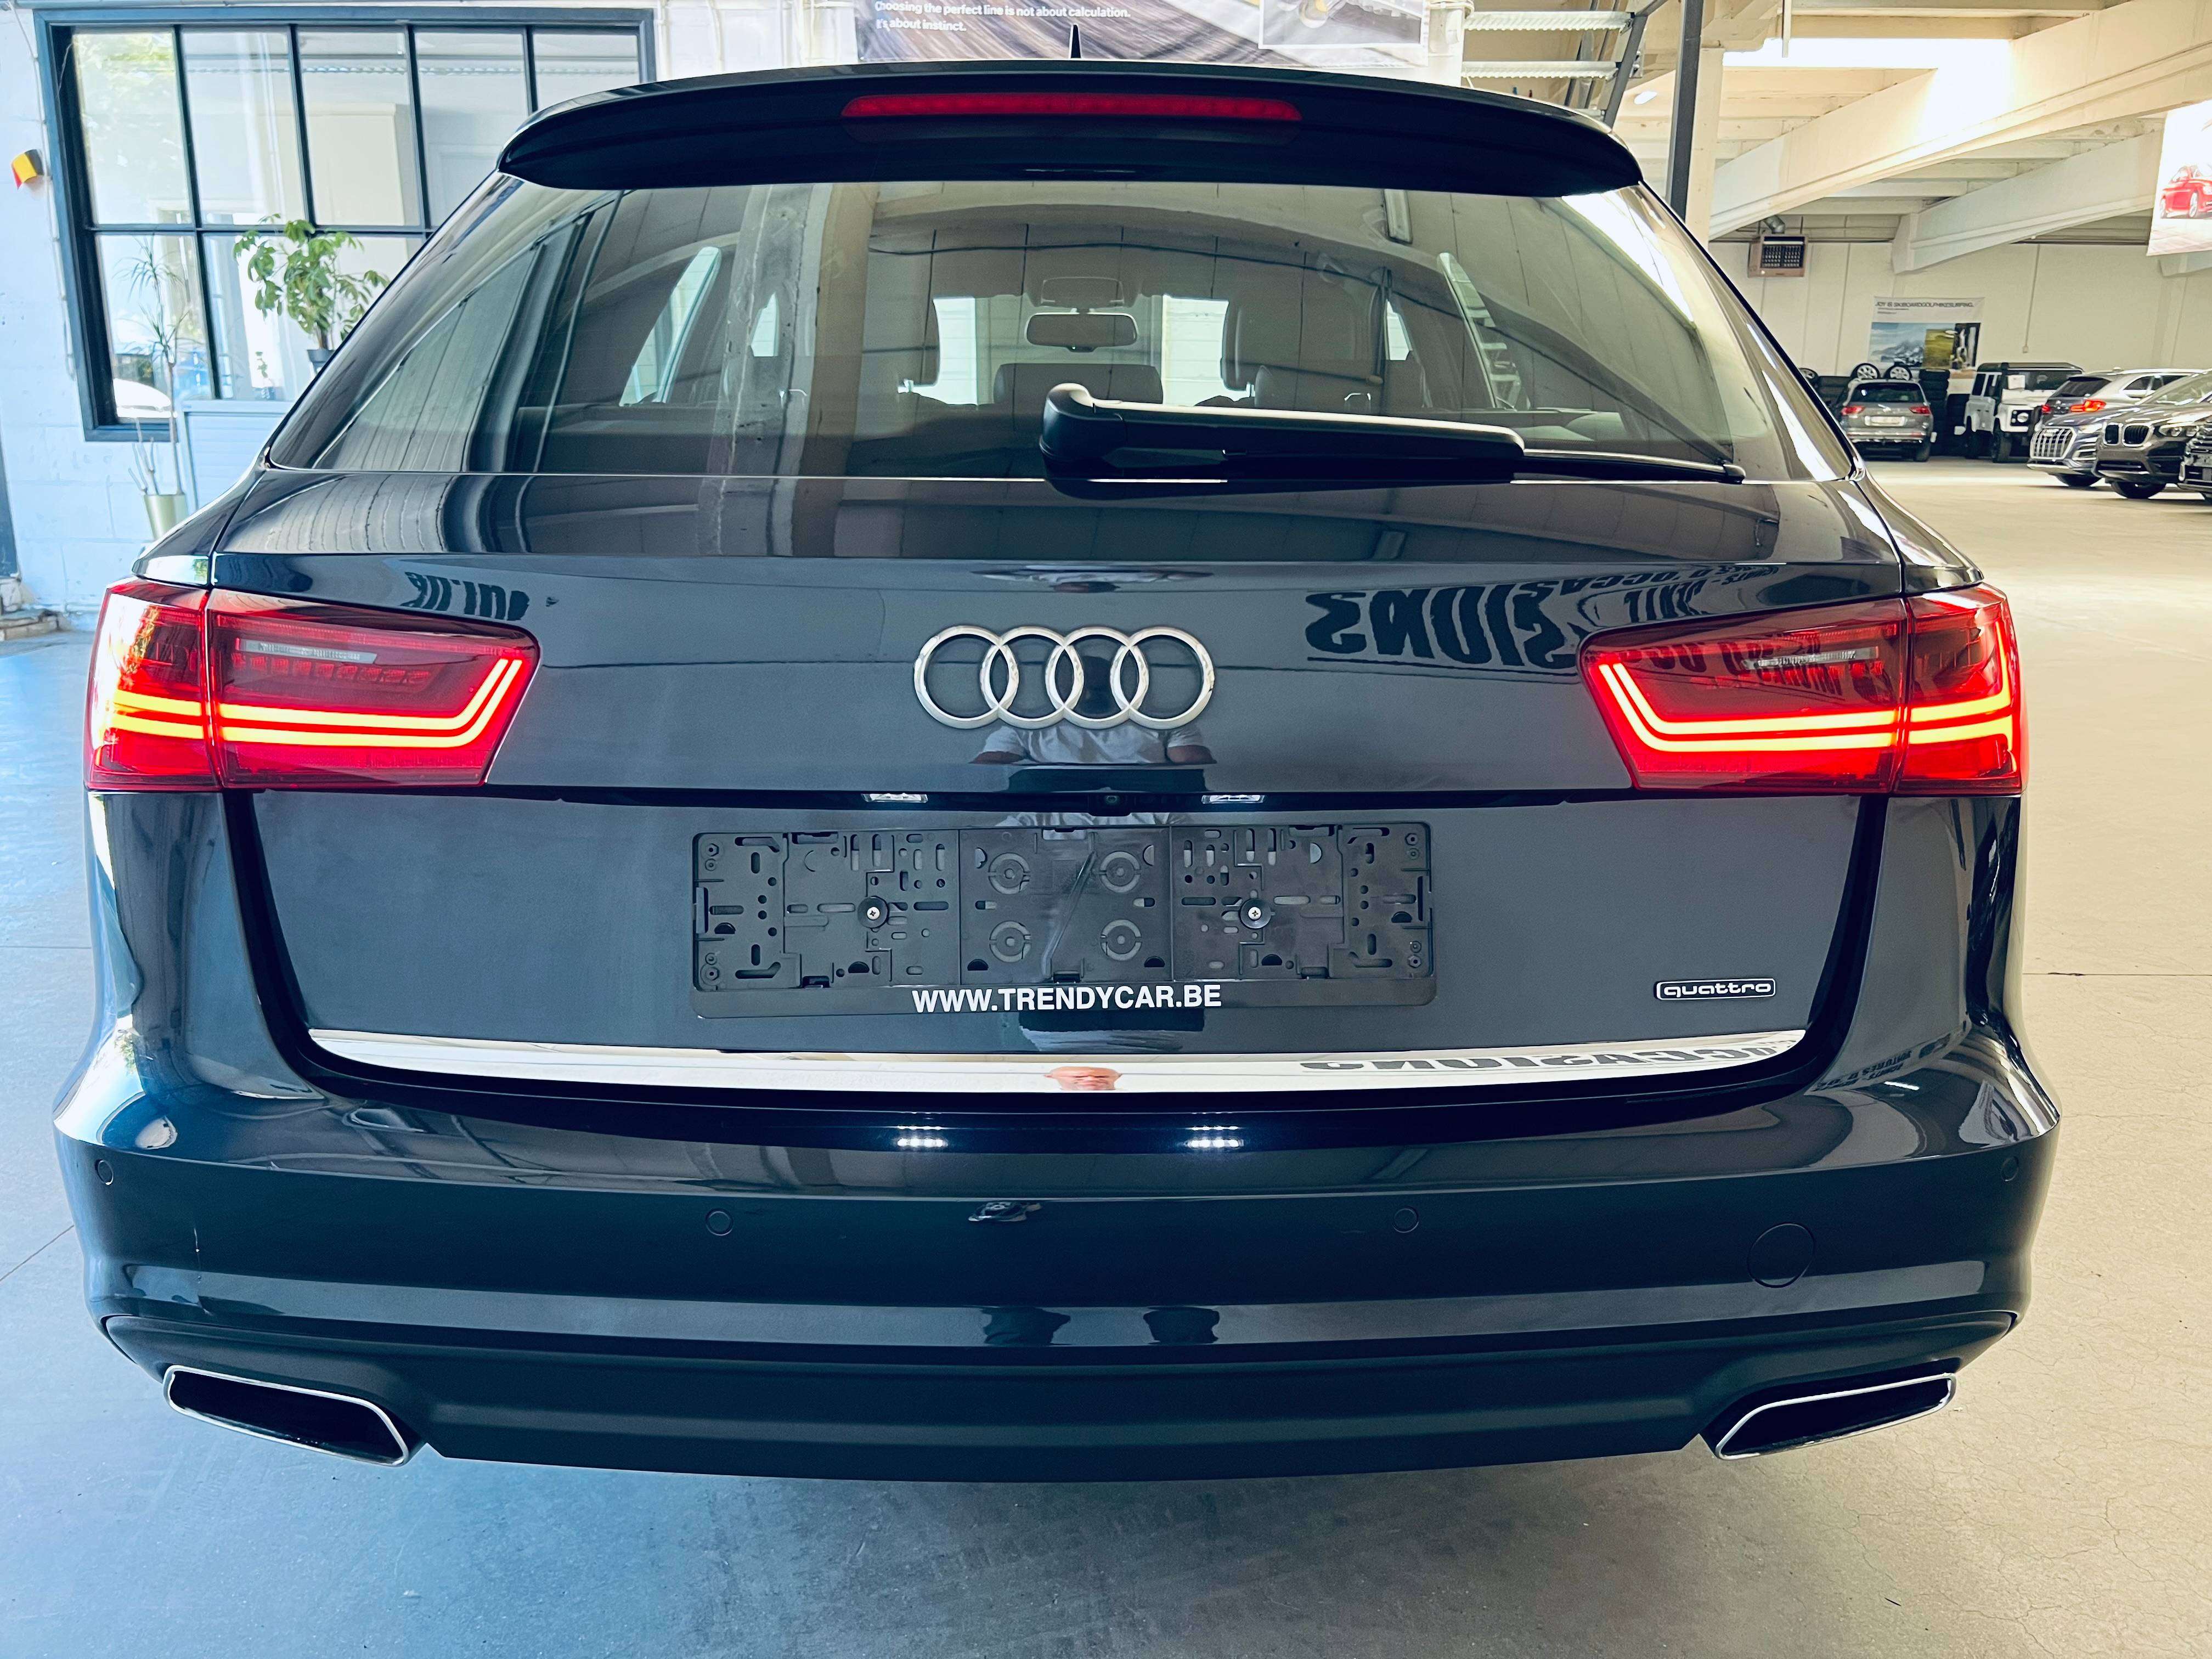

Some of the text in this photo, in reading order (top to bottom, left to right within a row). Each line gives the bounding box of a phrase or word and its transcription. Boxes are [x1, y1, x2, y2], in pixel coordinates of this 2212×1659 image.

[924, 3, 942, 13] the
[943, 4, 982, 15] perfect
[983, 5, 1004, 15] line
[1005, 5, 1014, 16] is
[1016, 7, 1035, 16] not
[1036, 7, 1067, 17] about
[1068, 7, 1131, 18] calculation.
[889, 18, 921, 29] about
[922, 20, 967, 31] instinct.
[1663, 983, 1771, 998] quattro
[912, 984, 1222, 1013] WWW.TRENDYCAR.BE
